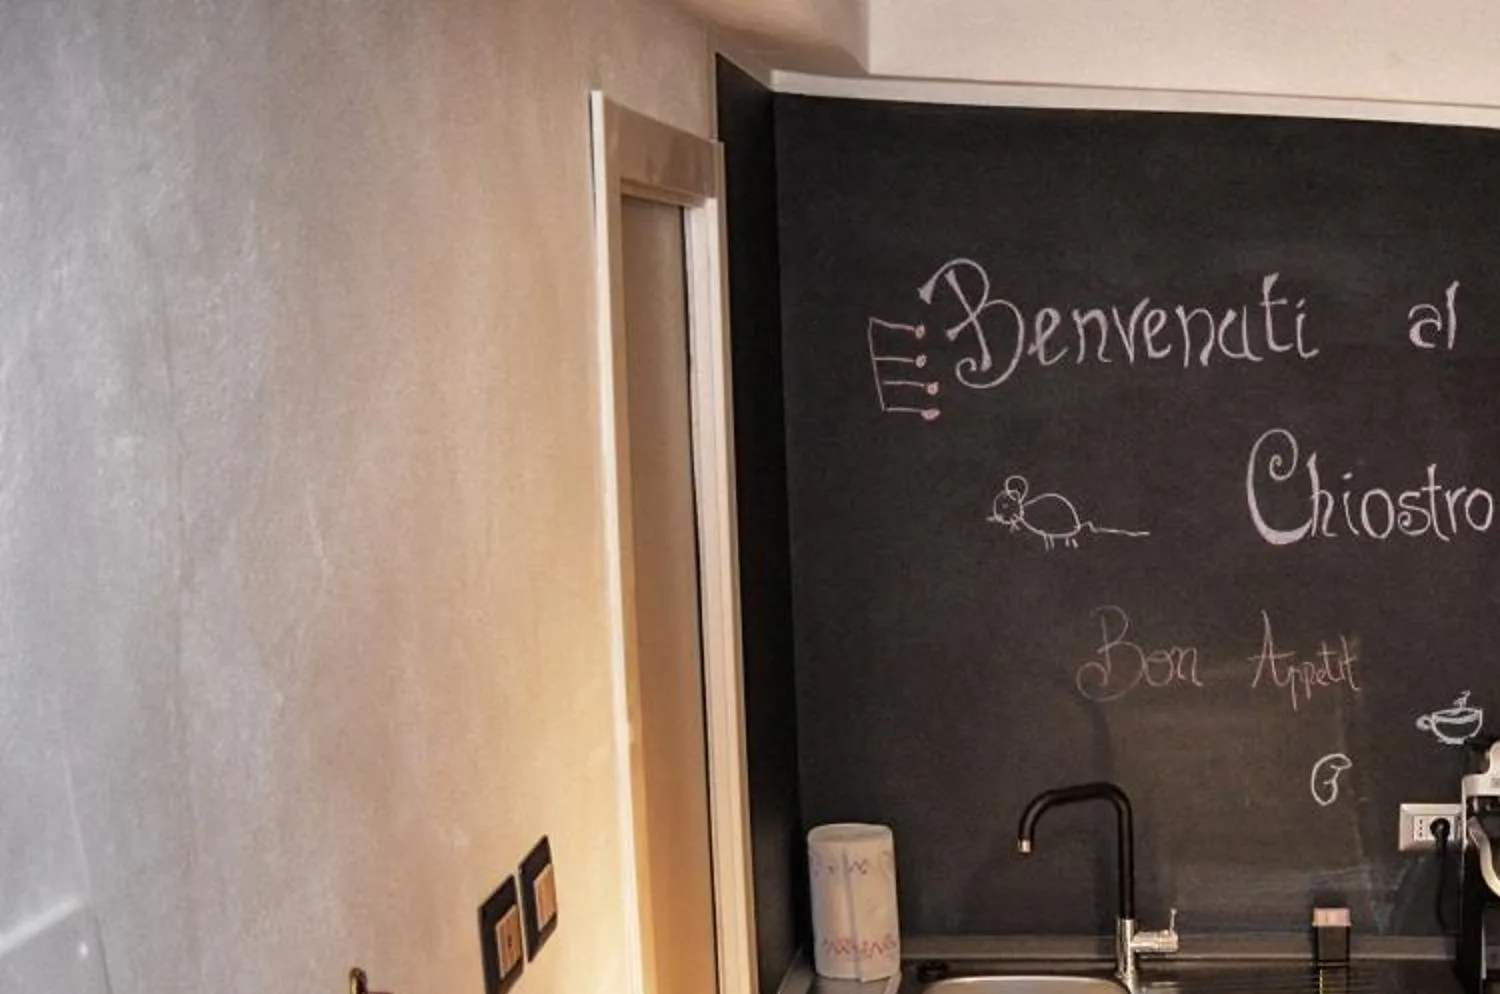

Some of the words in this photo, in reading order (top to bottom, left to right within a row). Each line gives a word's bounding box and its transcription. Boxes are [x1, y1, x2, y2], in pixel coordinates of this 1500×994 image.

[918, 257, 1319, 389] Benvenuti
[1407, 280, 1461, 350] al
[1246, 428, 1494, 545] Chiostro
[1075, 604, 1204, 702] Bon
